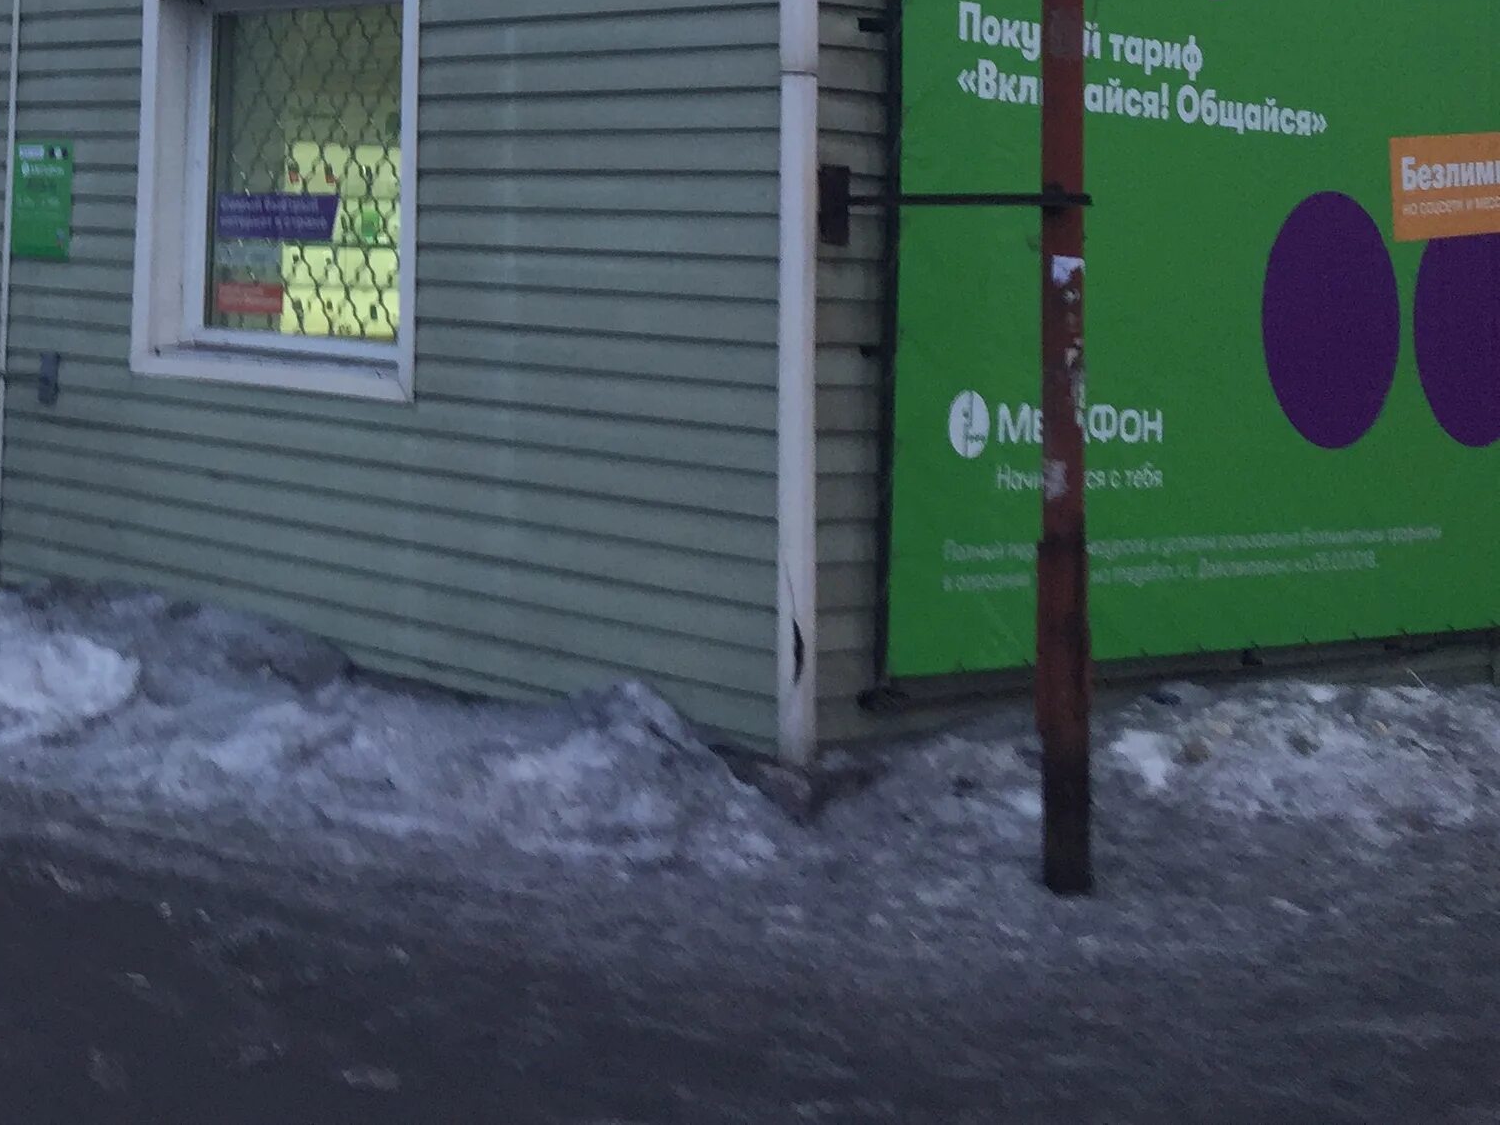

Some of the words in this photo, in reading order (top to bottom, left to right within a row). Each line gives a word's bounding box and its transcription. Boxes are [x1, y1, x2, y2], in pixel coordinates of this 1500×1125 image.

[958, 0, 1101, 62] Покуй
[1108, 34, 1203, 82] тариф
[956, 58, 1170, 121] «Вклайся!
[1176, 83, 1328, 137] Общайся»
[996, 401, 1163, 444] МЕФОН
